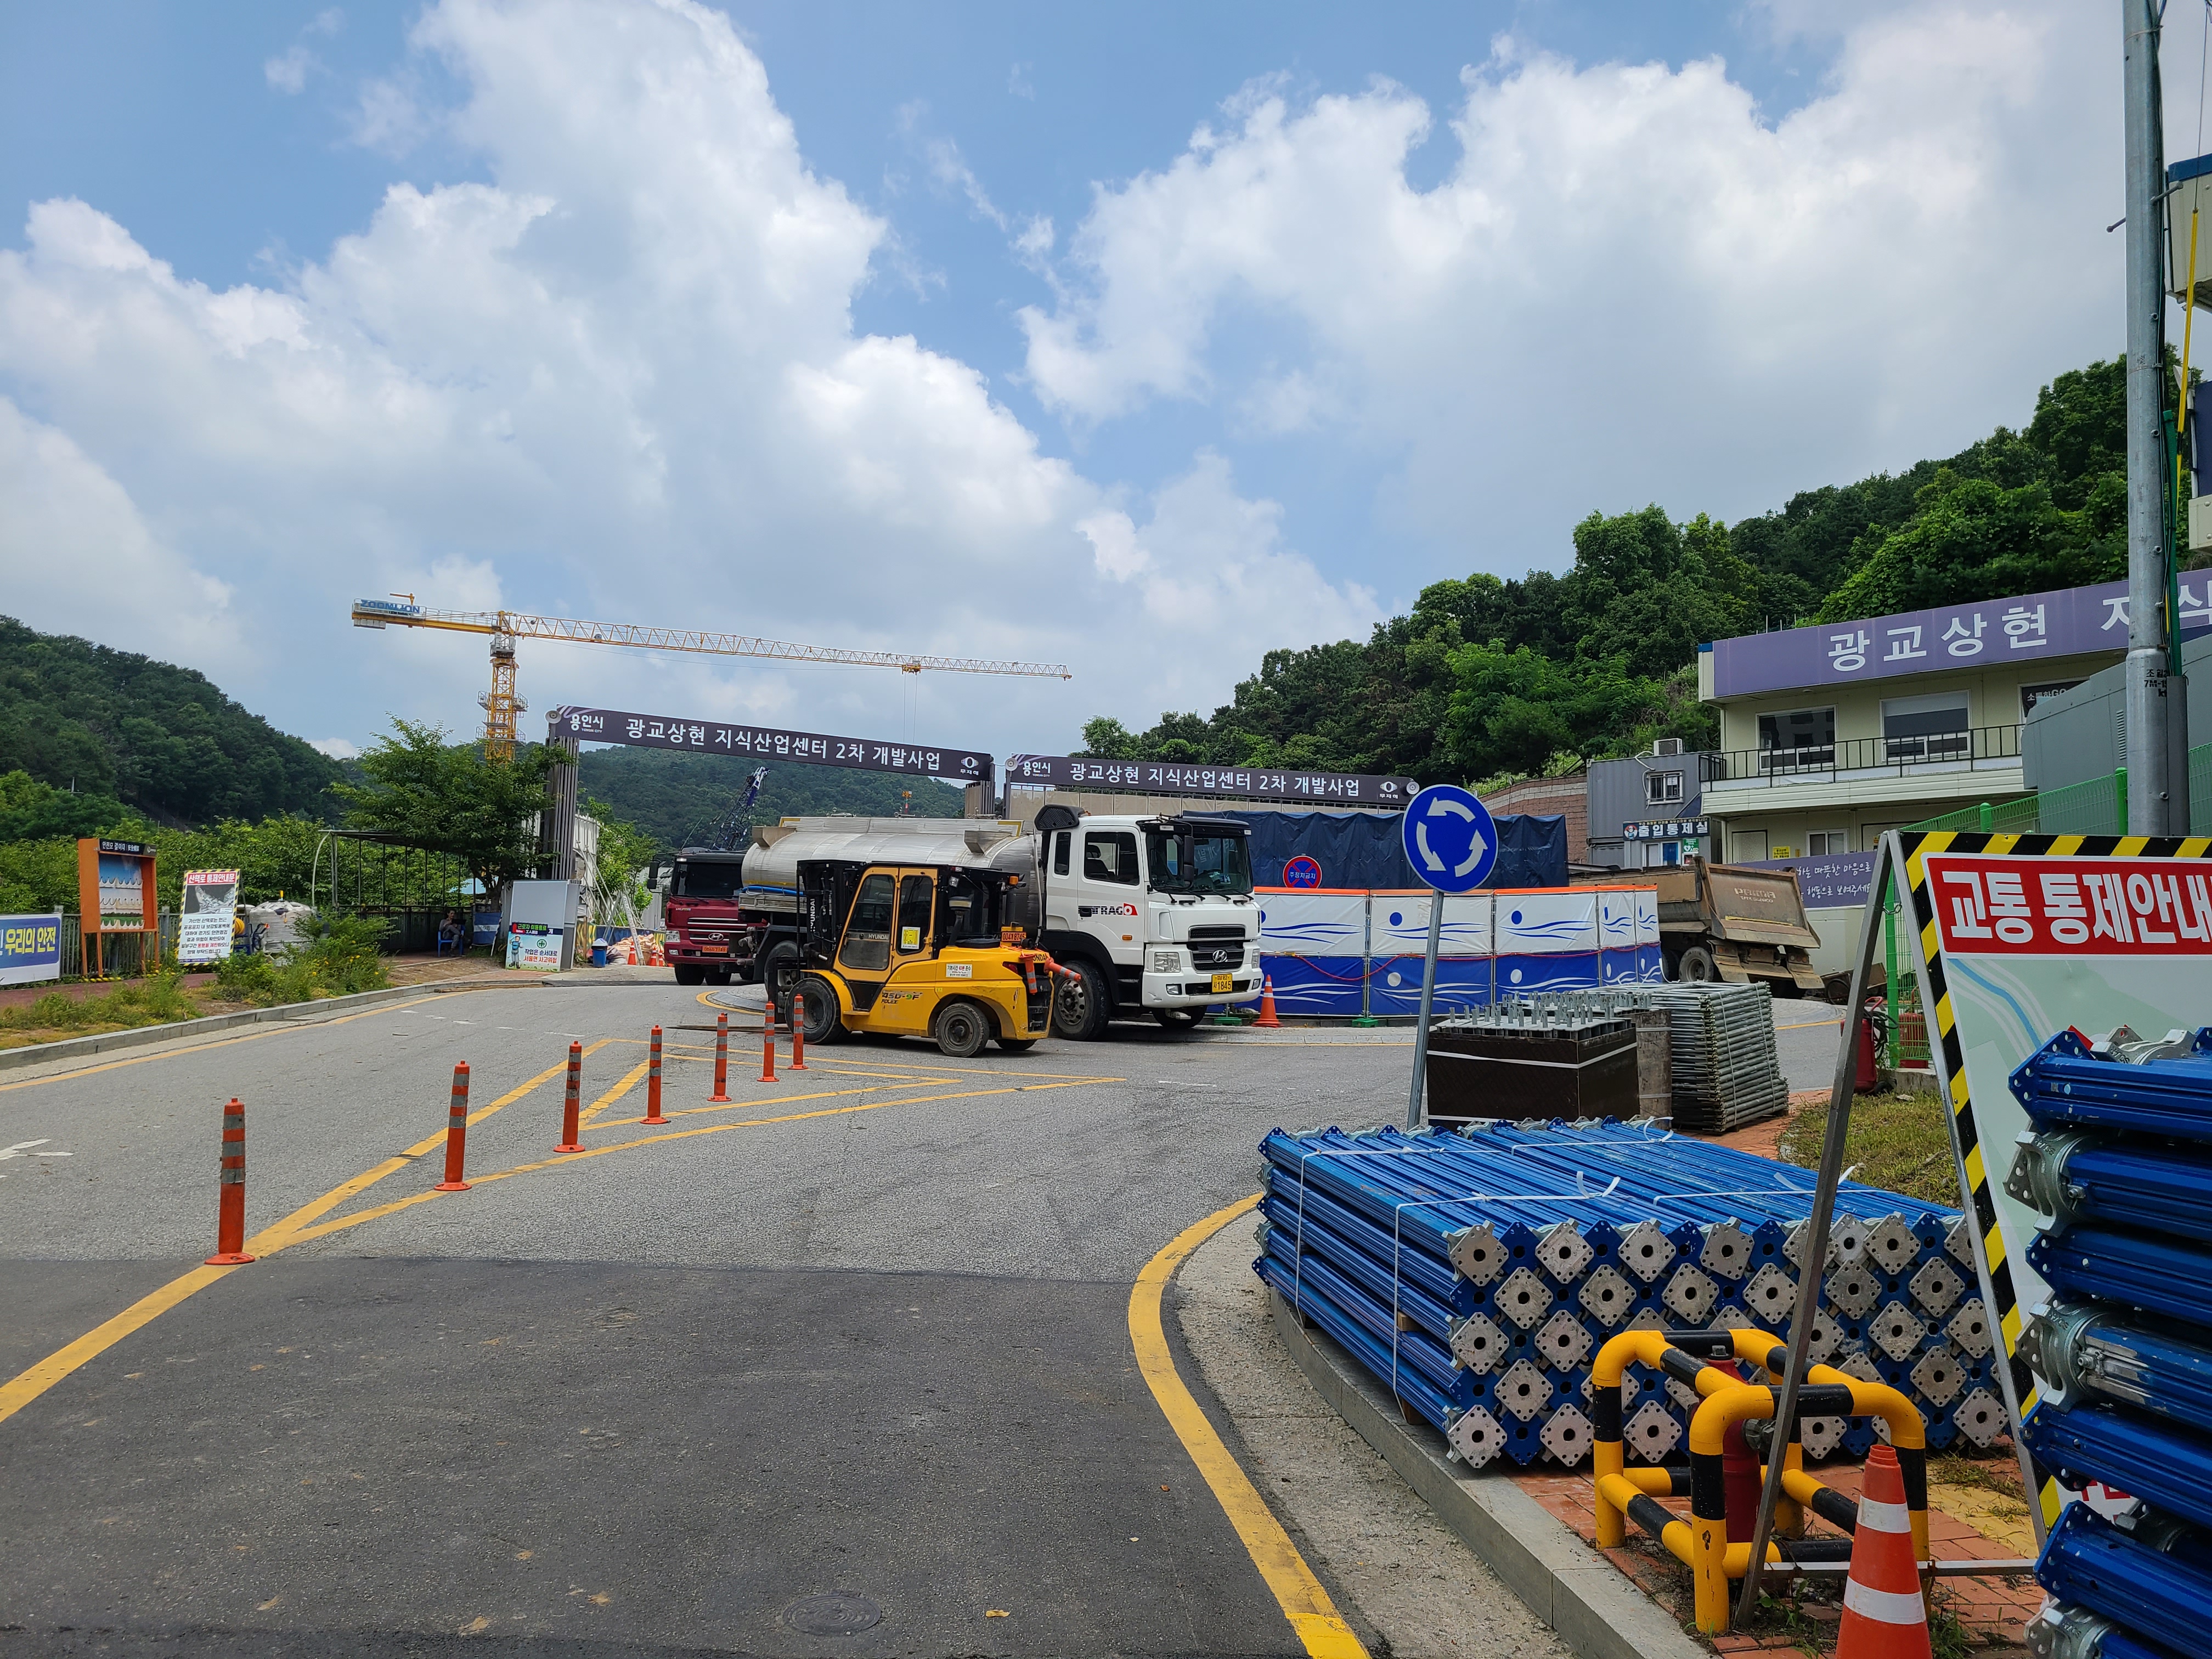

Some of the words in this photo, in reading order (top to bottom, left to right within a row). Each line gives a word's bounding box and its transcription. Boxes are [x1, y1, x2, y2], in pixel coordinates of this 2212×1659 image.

[360, 599, 420, 613] ZOOMLION
[1827, 604, 2047, 672] 광교상현
[570, 714, 603, 731] 용인시
[625, 718, 705, 746] 광교상현
[715, 729, 827, 759] 지식산업센터
[836, 743, 865, 763] 2차
[872, 746, 940, 770] 개발사업
[1023, 761, 1050, 776] 용인시
[1070, 763, 1139, 784] 광교상현
[1148, 768, 1250, 791] 지식산업센터
[1259, 775, 1286, 793] 2차
[1294, 776, 1359, 797] 개발사업
[1638, 821, 1708, 838] 출입통제실
[102, 841, 114, 850] 안전모
[188, 874, 206, 883] 산책로
[207, 873, 235, 883] 통제안내문
[1814, 864, 1841, 878] 따뜻한
[1843, 862, 1871, 876] 마음으로
[1807, 885, 1833, 899] 행동으로
[1942, 871, 2033, 944] 교통
[5, 928, 35, 956] 우리의
[37, 927, 56, 952] 안전
